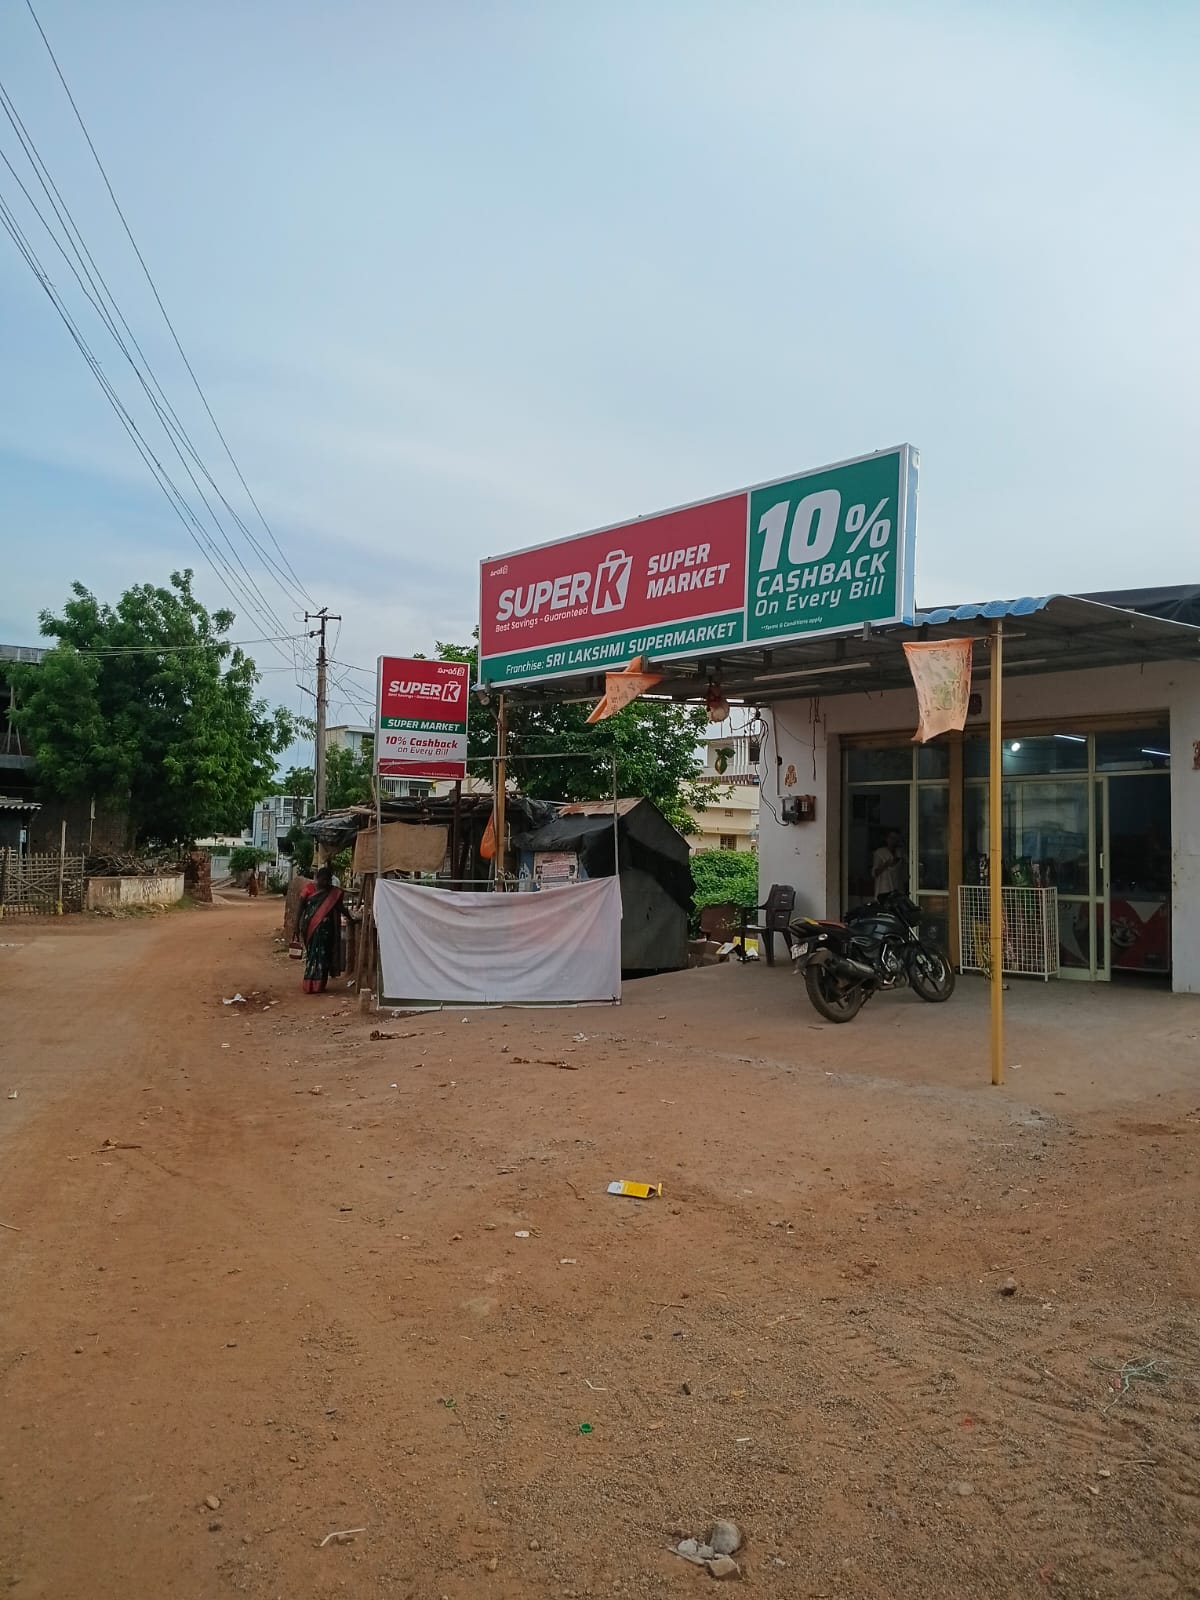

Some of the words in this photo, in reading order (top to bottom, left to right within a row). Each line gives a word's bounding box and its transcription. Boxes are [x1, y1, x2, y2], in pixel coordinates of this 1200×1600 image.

[757, 489, 891, 573] 10%
[647, 543, 711, 576] SUPER
[756, 550, 890, 598] CASHBACK
[496, 571, 591, 621] SUPER
[646, 563, 731, 600] MARKET
[755, 600, 779, 617] On
[785, 588, 842, 612] Every
[849, 575, 885, 600] Bill
[495, 622, 510, 633] Best
[511, 617, 538, 629] Savings
[544, 605, 589, 623] Guaranteed
[506, 661, 545, 675] Franchise:
[545, 652, 565, 668] SRI
[568, 641, 625, 664] LAKSHMI
[628, 621, 737, 654] SUPERMARKET
[388, 680, 442, 697] SUPER
[385, 735, 407, 745] 10%
[410, 737, 458, 749] Cashback
[387, 718, 419, 729] SUPER
[420, 721, 461, 732] MARKET
[410, 747, 433, 756] Every
[435, 747, 449, 756] Bill
